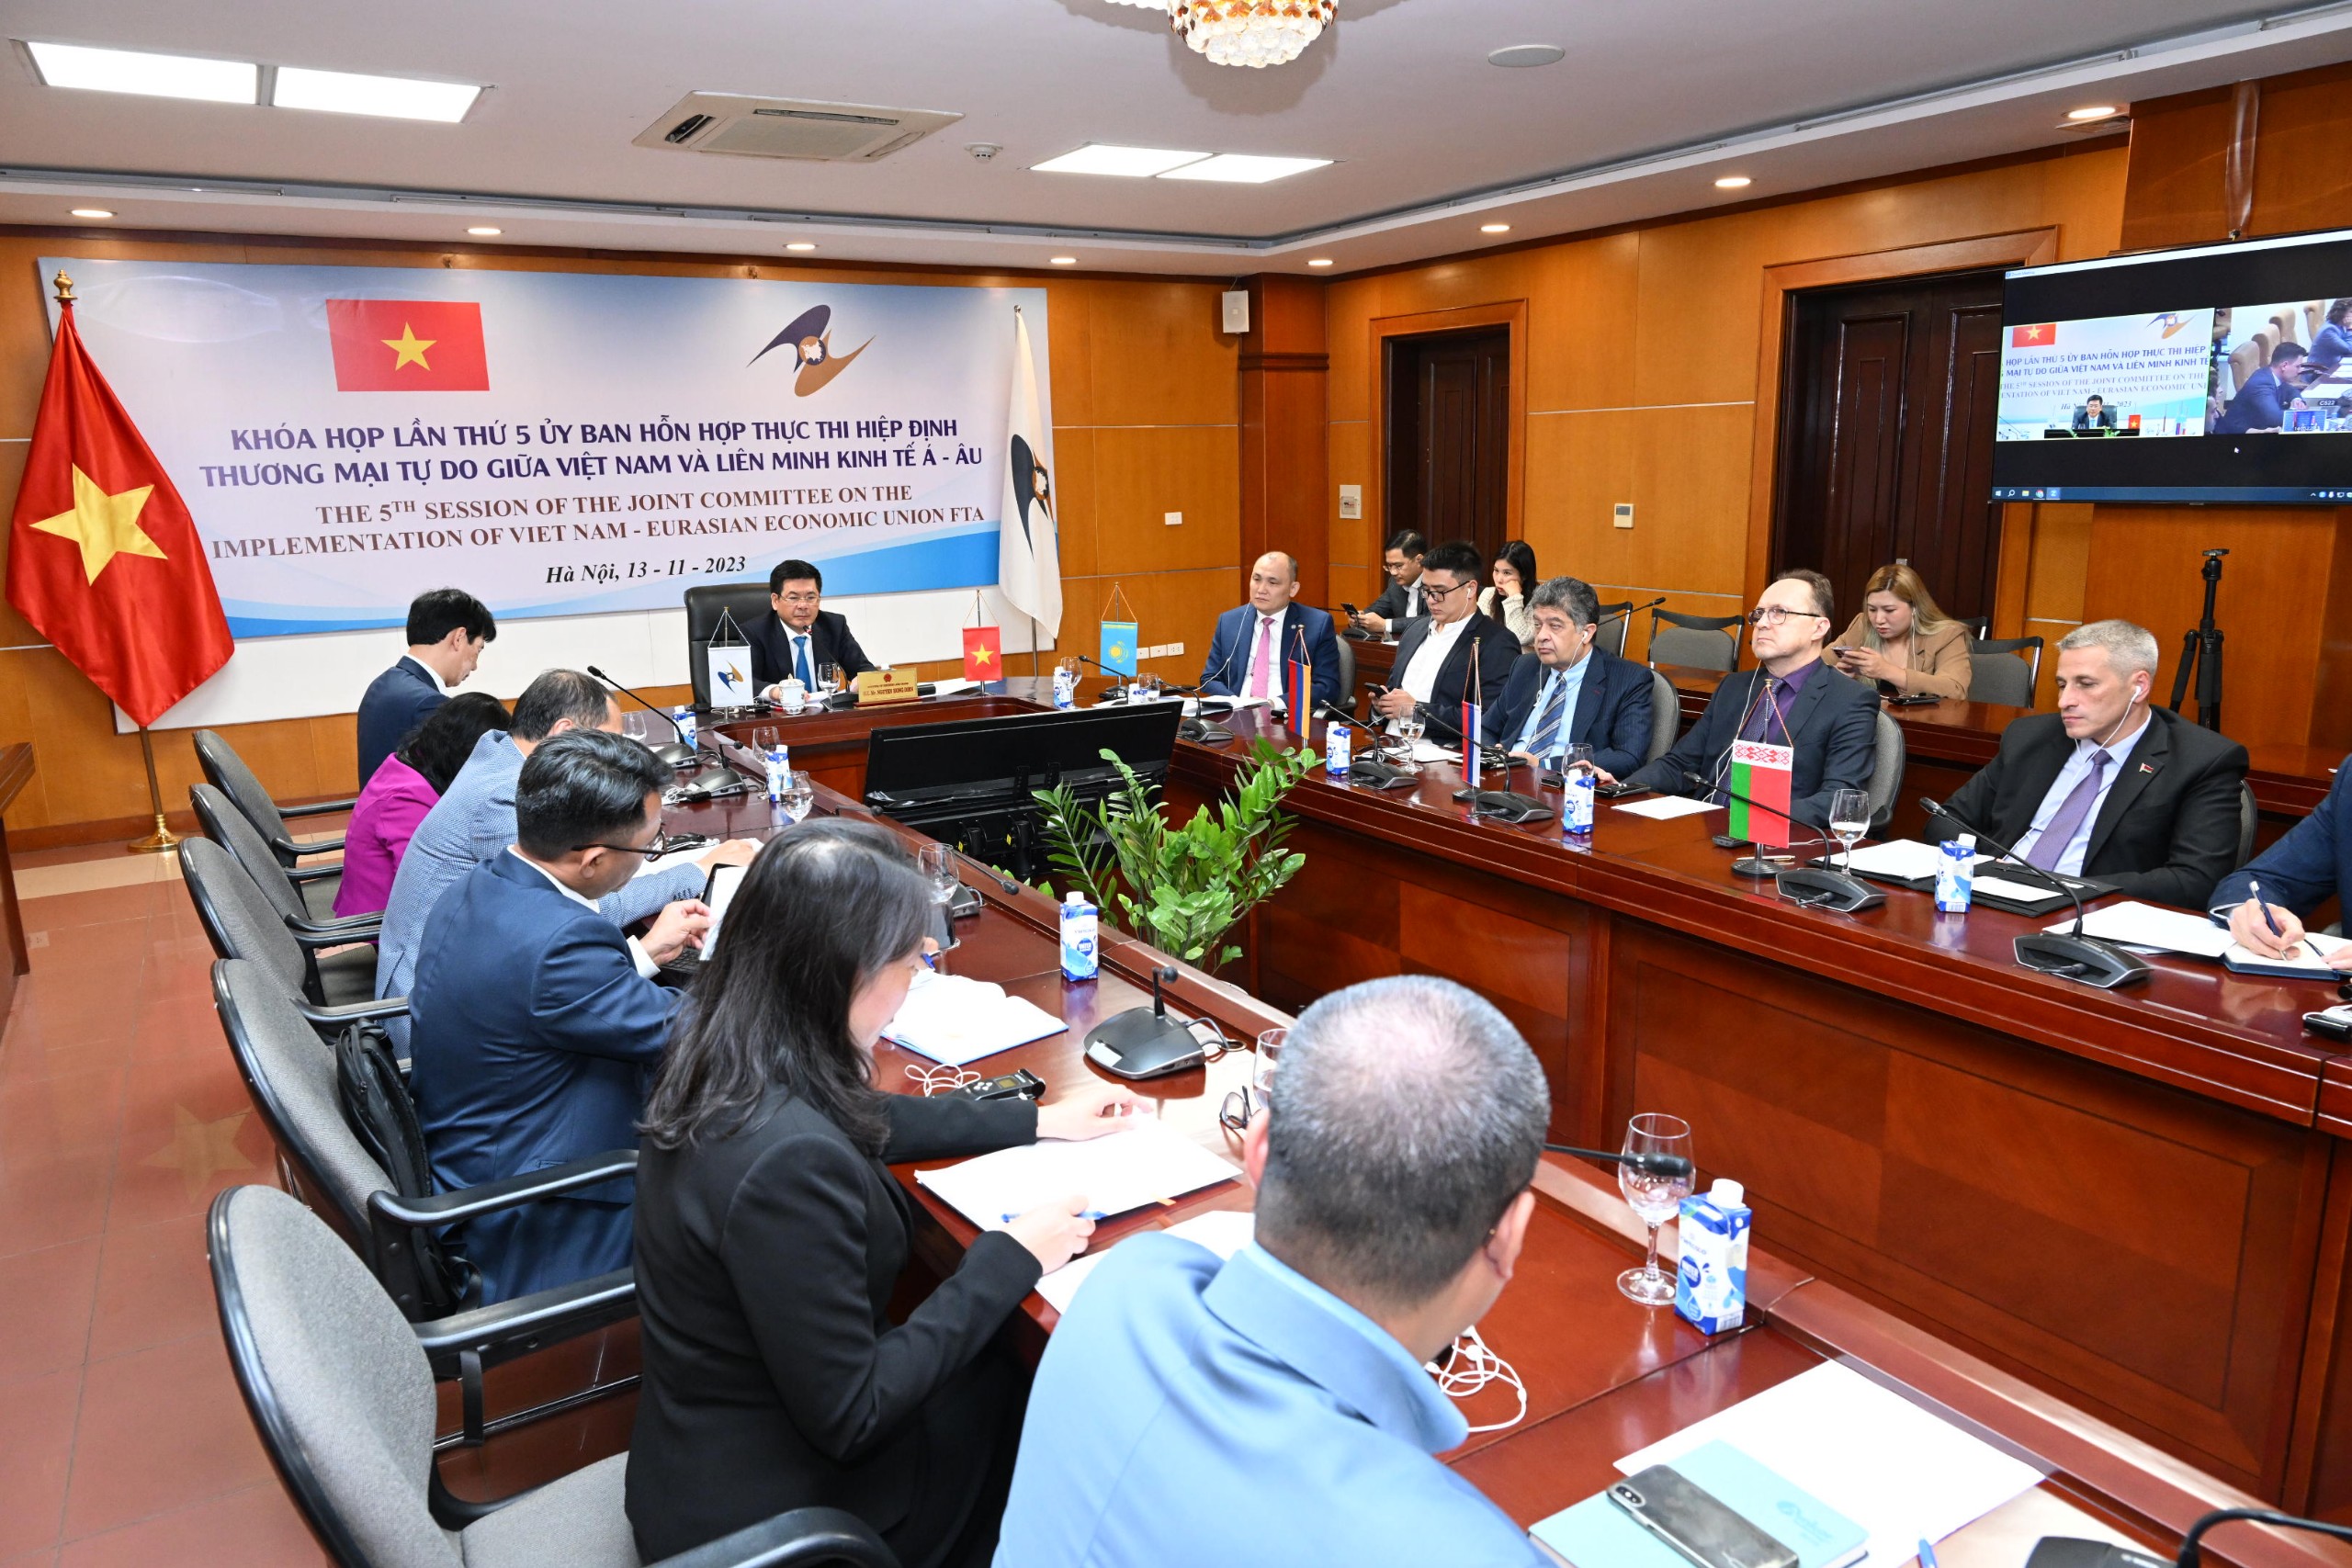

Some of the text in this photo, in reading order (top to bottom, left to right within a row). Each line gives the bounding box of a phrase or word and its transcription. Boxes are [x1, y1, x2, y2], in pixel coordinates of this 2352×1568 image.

[2081, 353, 2098, 361] BAN
[232, 415, 957, 454] KHÓA HỌP LẦN THỨ 5 ỦY BAN HỖN HỢP THỰC THI HIỆP ĐỊNH
[199, 463, 324, 487] THƯƠNG
[334, 462, 390, 487] MẠI
[396, 459, 432, 486] TỰ
[440, 459, 478, 479] DO
[487, 454, 551, 479] GIỮA
[556, 452, 608, 480] VIỆT
[616, 455, 672, 475] NAM
[678, 448, 709, 473] VÀ
[717, 448, 764, 472] LIÊN
[772, 451, 830, 470] MINH
[837, 450, 888, 468] KINH
[893, 442, 917, 467] TẾ
[922, 443, 937, 466] Á
[956, 443, 982, 465] ÂU
[316, 485, 912, 525] THE 5TH SESSION OF THE JOINT COMMITTEE ON THE
[211, 529, 463, 558] IMPLEMENTATION
[470, 527, 503, 546] OF
[509, 525, 567, 544] VIET
[573, 522, 627, 540] NAM
[647, 515, 758, 537] EURASIAN
[764, 511, 877, 533] ECONOMIC
[884, 507, 944, 525] UNION
[950, 505, 985, 522] FTA
[545, 566, 574, 584] Hà
[582, 564, 619, 584] Nội,
[628, 561, 647, 579] 13
[667, 558, 685, 576] 11
[705, 557, 746, 574] 2023
